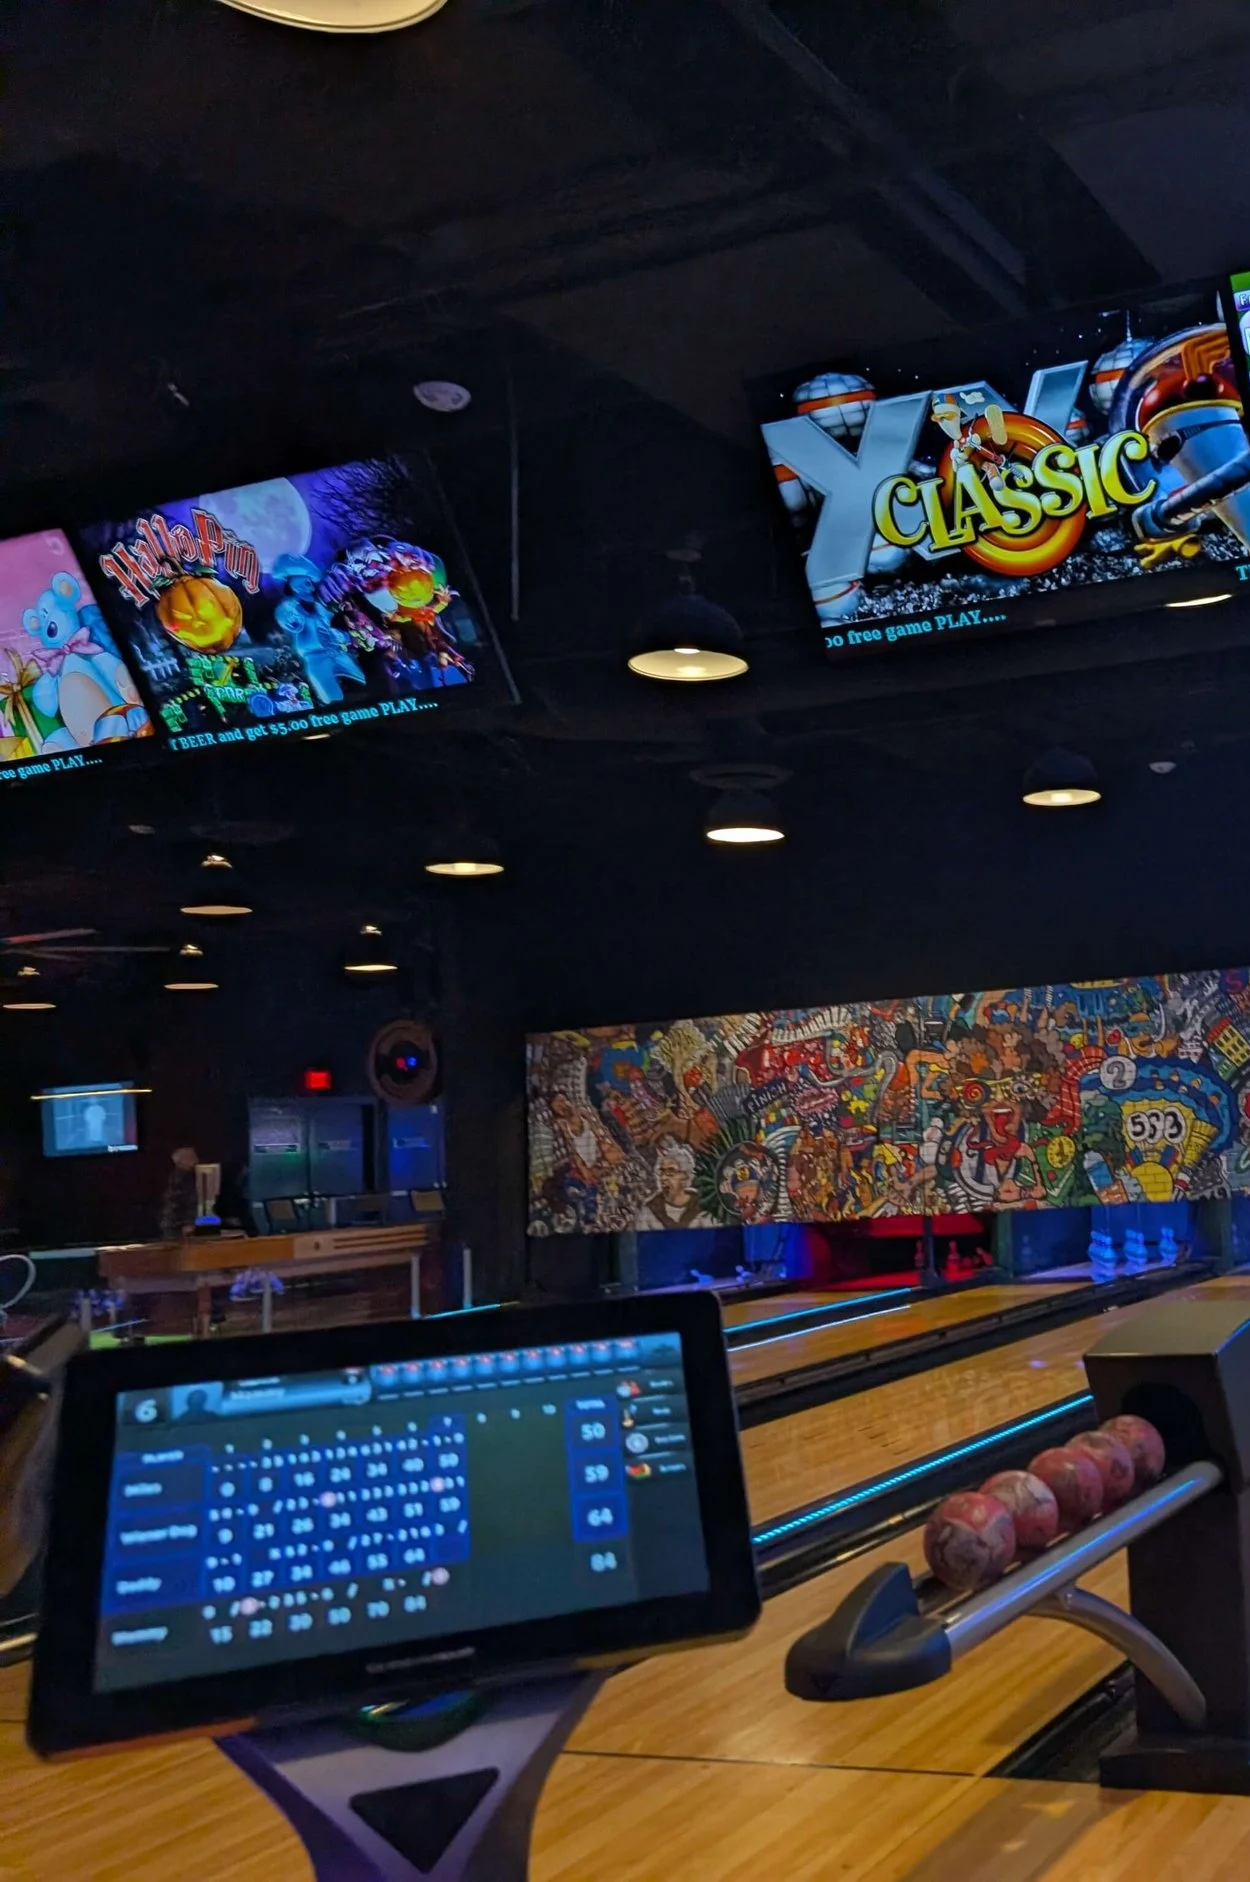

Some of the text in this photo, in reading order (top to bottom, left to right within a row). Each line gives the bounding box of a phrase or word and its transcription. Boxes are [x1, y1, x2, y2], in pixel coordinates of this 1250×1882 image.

[872, 429, 1156, 553] CLASSIC
[847, 629, 882, 646] free
[886, 620, 932, 642] game
[180, 732, 215, 750] BEER
[219, 727, 244, 745] and
[245, 726, 268, 741] get
[311, 712, 339, 728] free
[341, 707, 379, 725] game
[17, 763, 51, 779] game
[1106, 1061, 1126, 1088] 2
[134, 1398, 157, 1422] 6
[581, 1422, 606, 1441] 50
[584, 1464, 609, 1483] 59
[587, 1507, 613, 1527] 64
